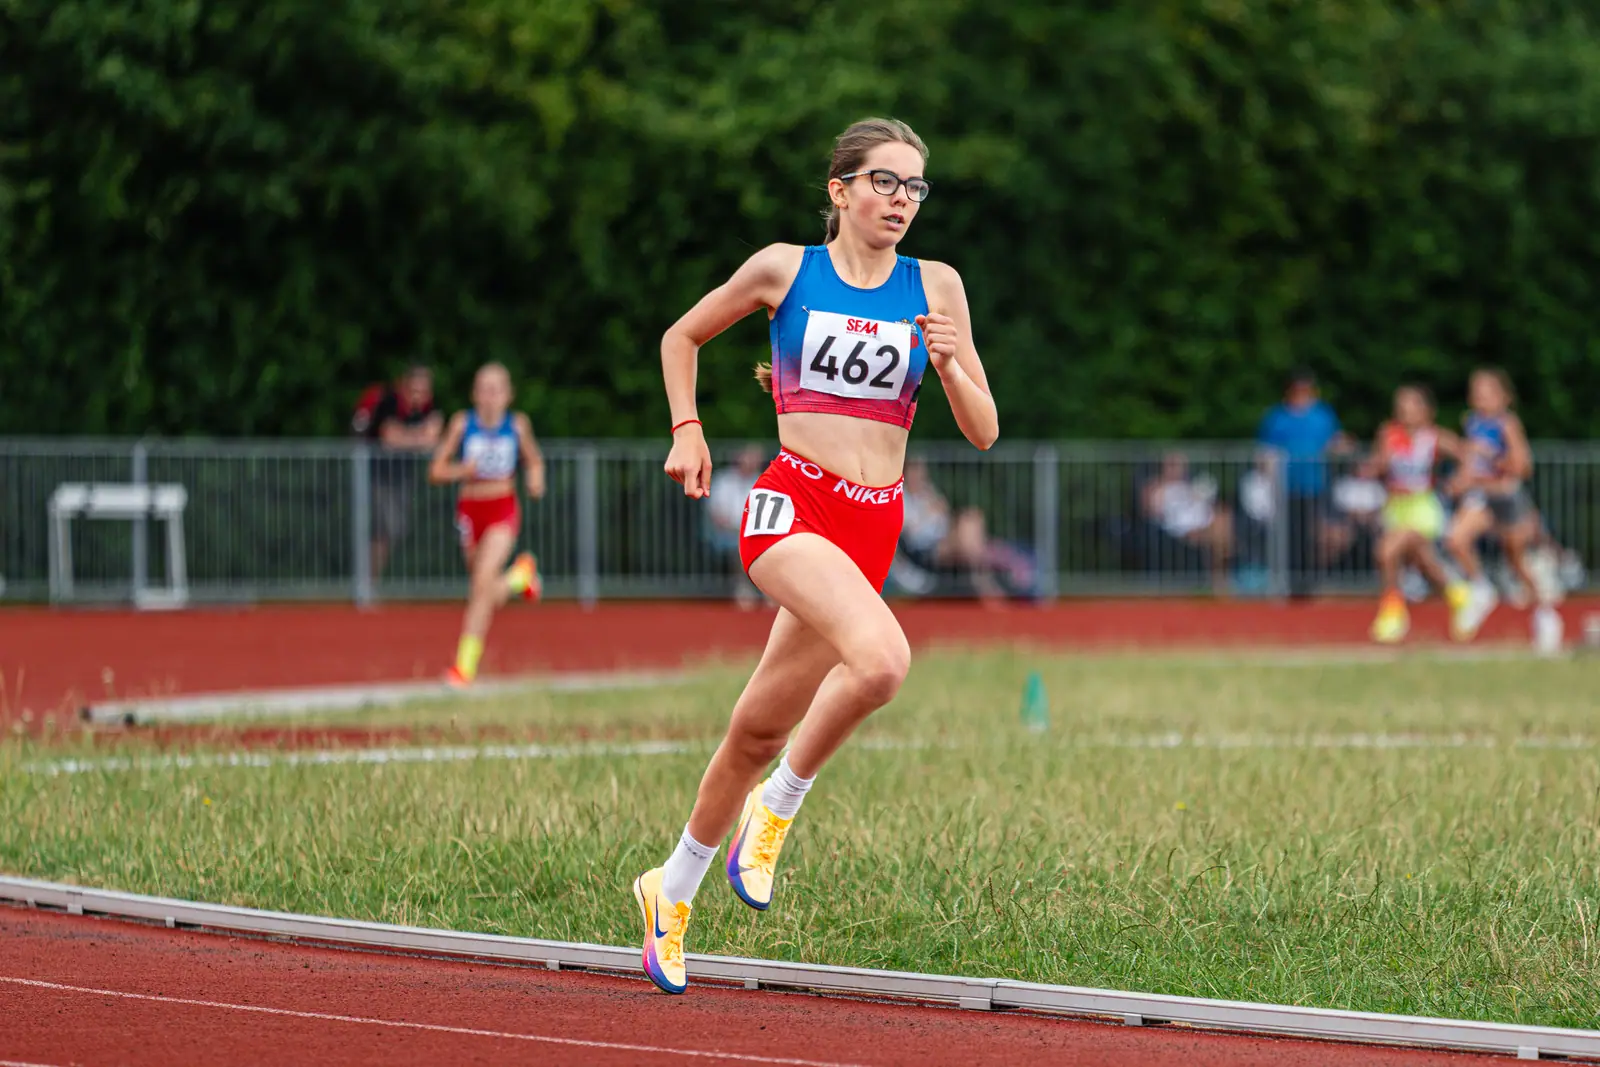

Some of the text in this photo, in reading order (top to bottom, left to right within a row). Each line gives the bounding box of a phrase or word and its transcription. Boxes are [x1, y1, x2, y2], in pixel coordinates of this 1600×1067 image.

[846, 318, 879, 336] SEAA
[809, 335, 900, 389] 462
[833, 479, 893, 505] NIKE
[753, 492, 785, 530] 11
